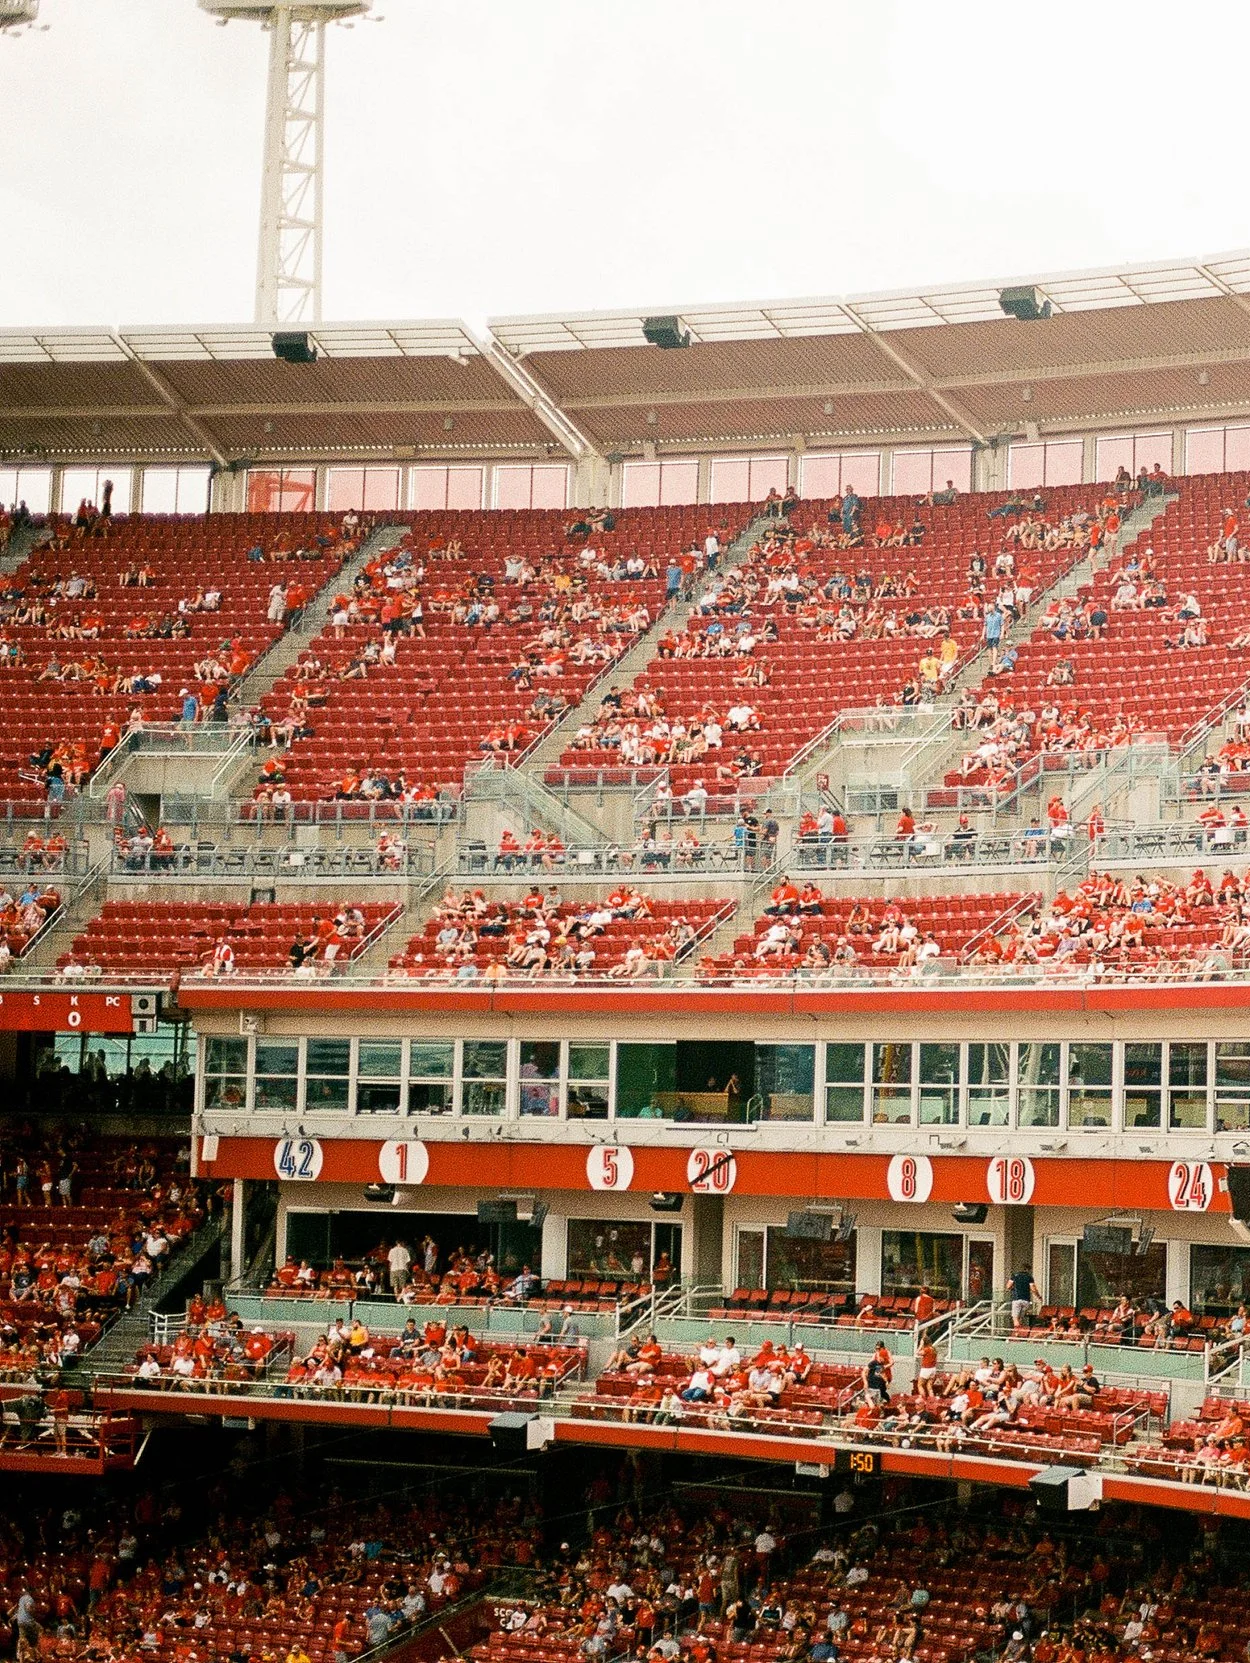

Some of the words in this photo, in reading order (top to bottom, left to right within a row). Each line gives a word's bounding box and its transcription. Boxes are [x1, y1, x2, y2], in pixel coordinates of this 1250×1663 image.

[33, 995, 40, 1005] S
[70, 995, 79, 1006] K
[105, 996, 120, 1007] PC
[279, 1140, 314, 1178] 42
[395, 1143, 408, 1181] 1
[603, 1148, 618, 1188] 5
[694, 1151, 730, 1191] 20
[901, 1158, 917, 1199] 8
[996, 1158, 1026, 1201] 18
[1174, 1163, 1207, 1209] 24
[849, 1453, 874, 1473] 1:50
